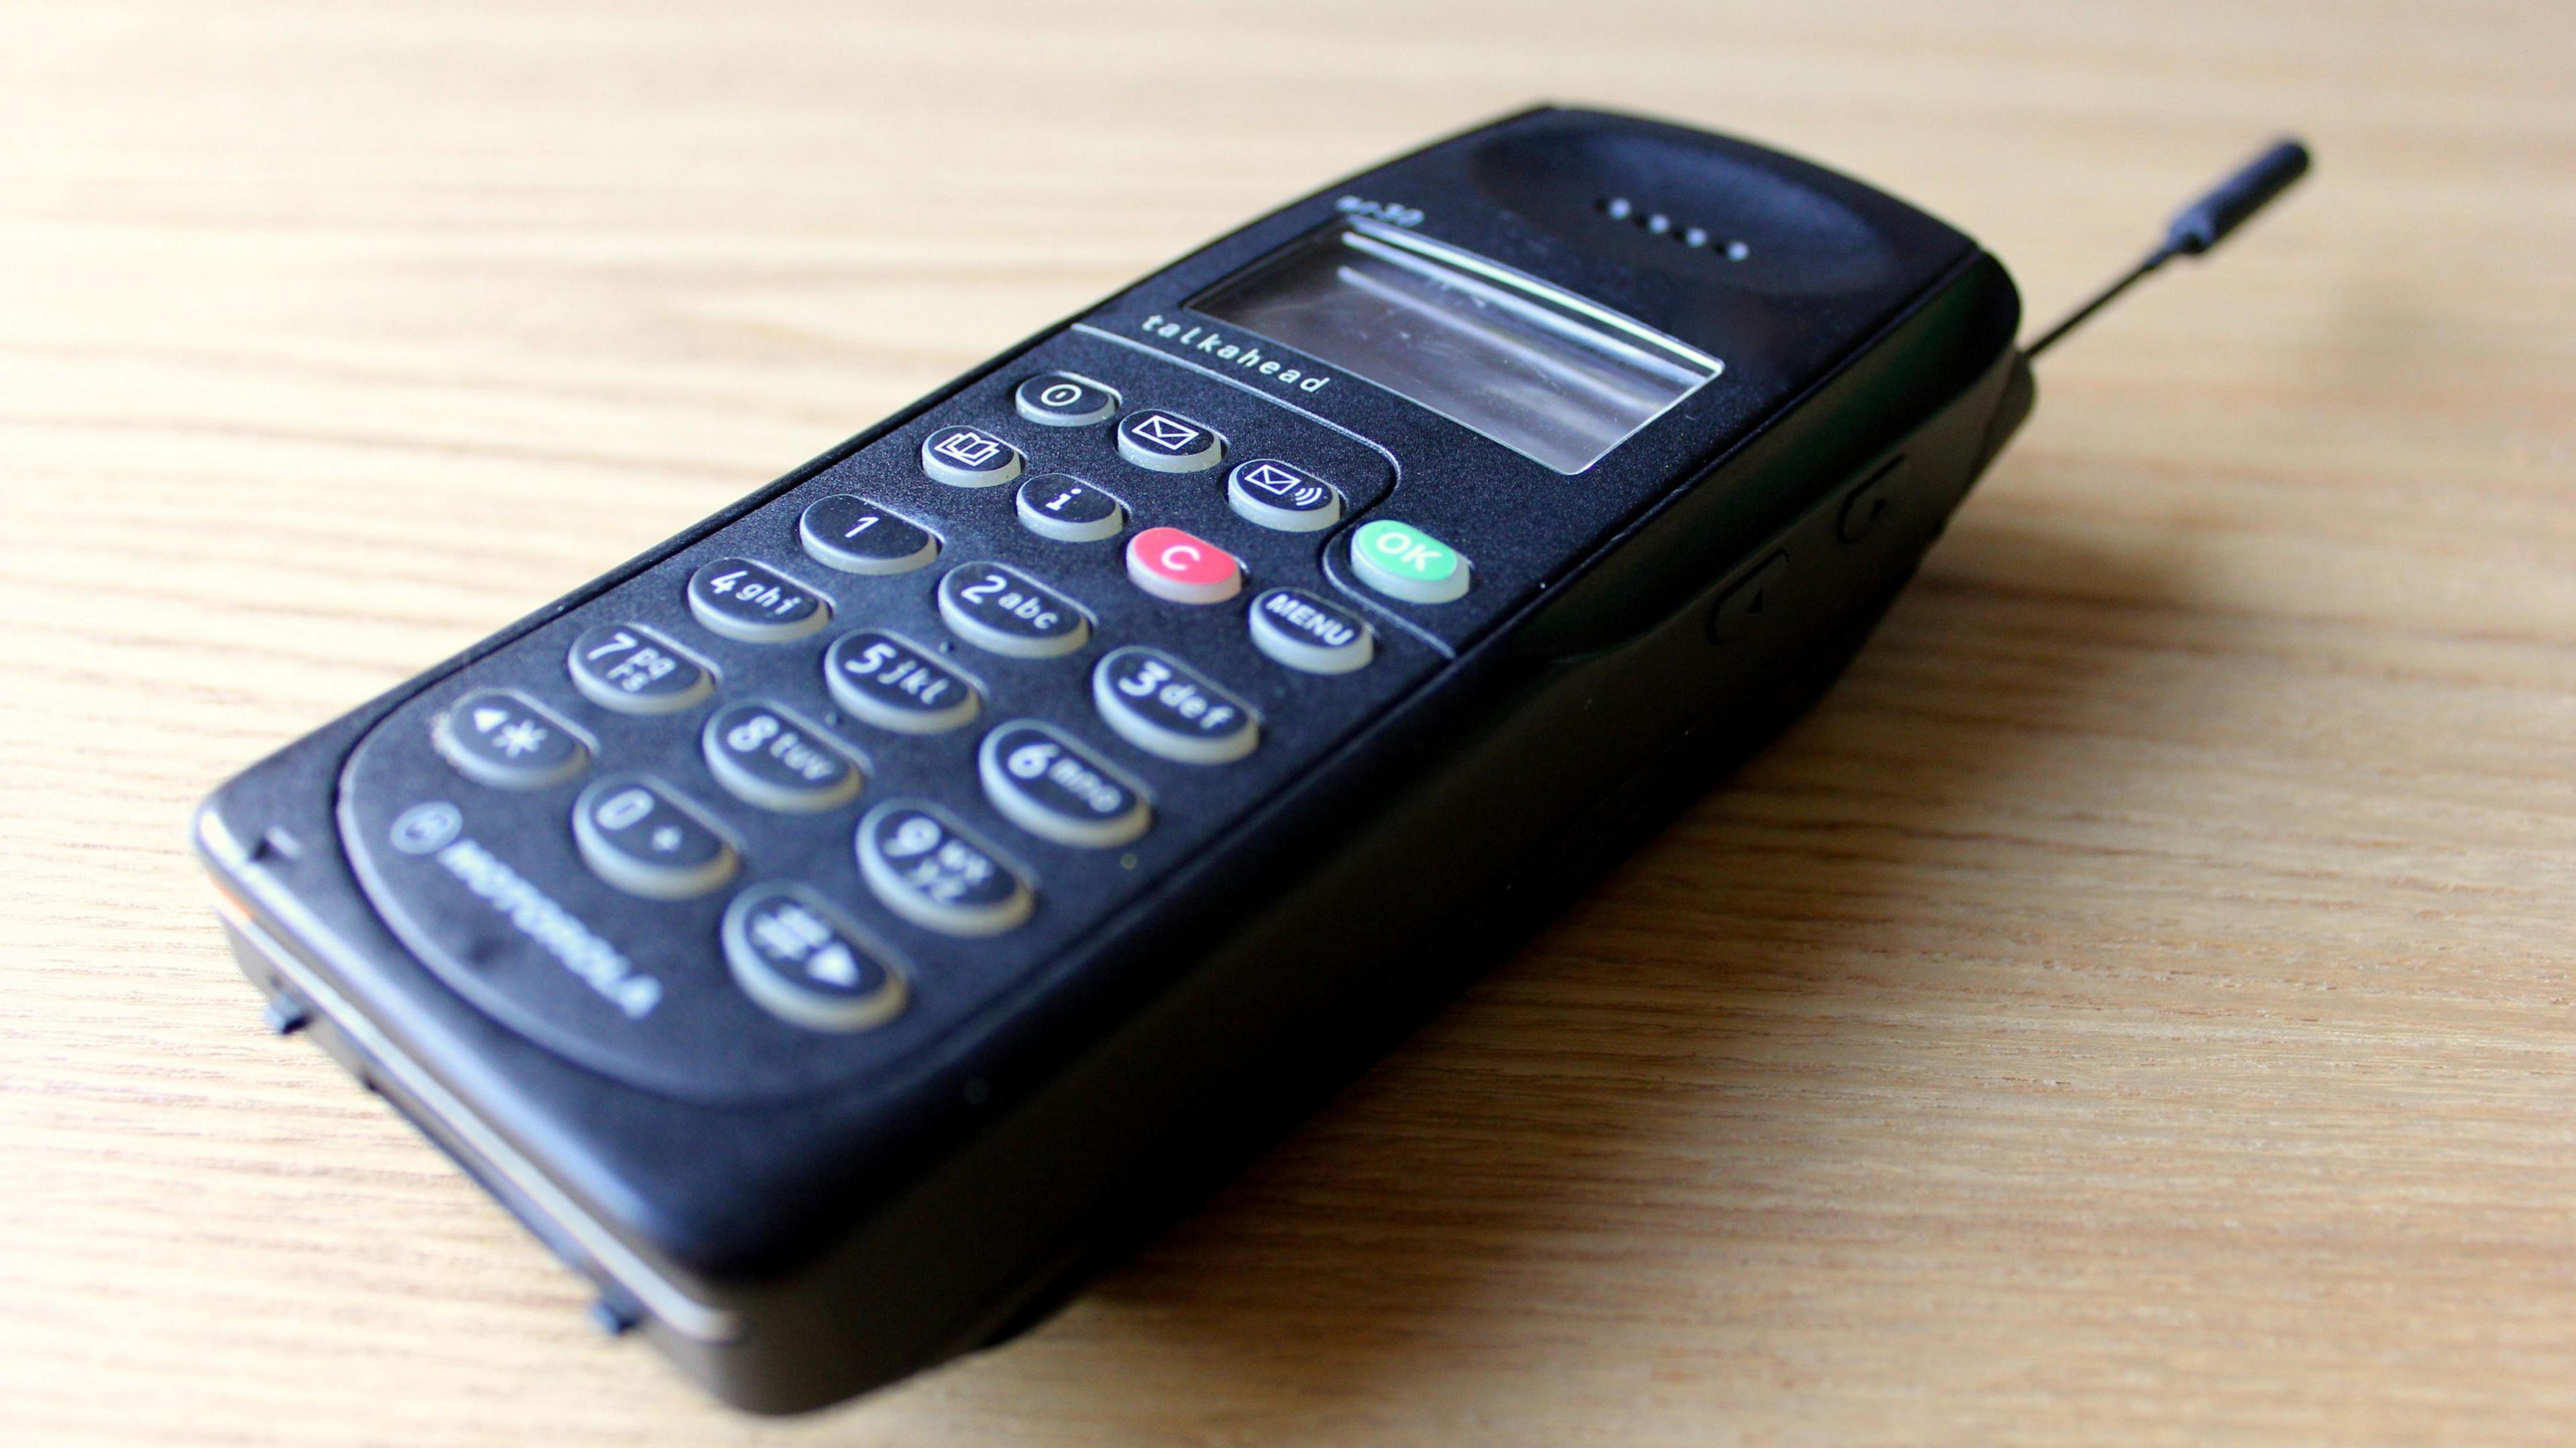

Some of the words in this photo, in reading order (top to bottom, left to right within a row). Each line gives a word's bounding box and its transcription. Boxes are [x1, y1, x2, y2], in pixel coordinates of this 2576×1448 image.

[1142, 314, 1331, 393] talkahead
[845, 516, 879, 538] 1
[1161, 545, 1200, 571] C
[1377, 531, 1442, 572] OK
[710, 570, 748, 594] 4
[735, 583, 802, 615] ghi
[961, 574, 1008, 604] 2
[998, 592, 1058, 629] abc
[1265, 594, 1354, 646] MENU
[586, 632, 638, 661] 7
[844, 643, 897, 673] 5
[877, 660, 950, 704] jkl
[1118, 660, 1172, 697] 3
[1159, 684, 1234, 729] def
[727, 715, 780, 753] 8
[1008, 743, 1060, 779] 6
[596, 788, 655, 831] 0
[883, 817, 942, 858] 9
